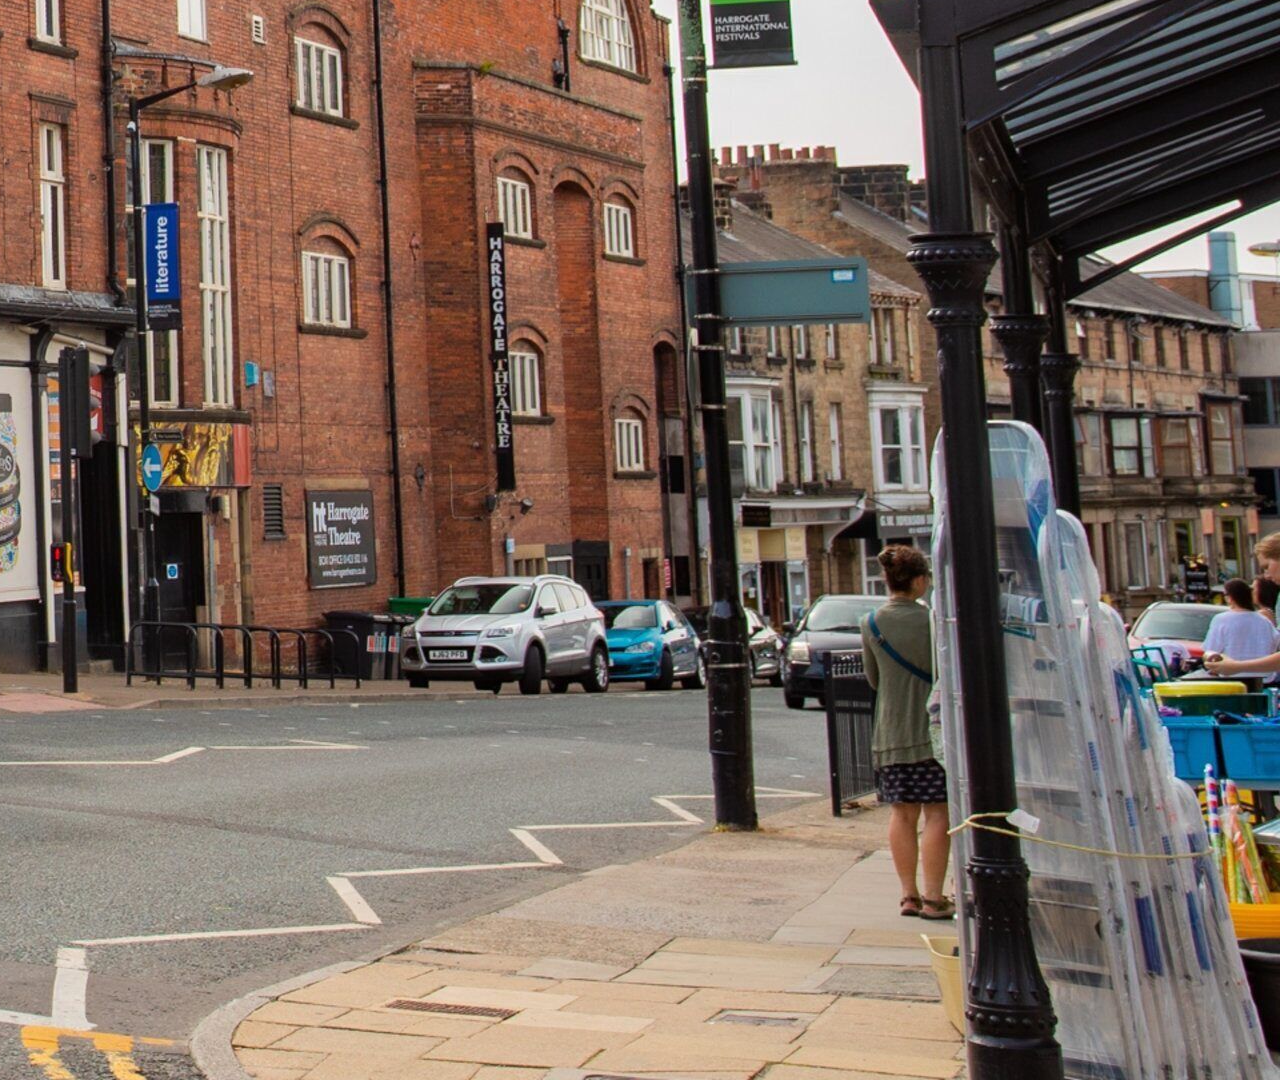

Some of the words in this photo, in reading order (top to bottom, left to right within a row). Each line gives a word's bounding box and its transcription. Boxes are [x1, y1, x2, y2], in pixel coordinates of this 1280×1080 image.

[714, 14, 770, 24] HARROGATE
[715, 21, 789, 33] INTERNATIONAL
[715, 32, 760, 42] FESTIVALS
[155, 216, 169, 293] literature
[490, 237, 505, 351] HARROGATE
[494, 358, 511, 448] THEATRE
[327, 502, 369, 525] Harrogate
[328, 526, 361, 546] Theatre
